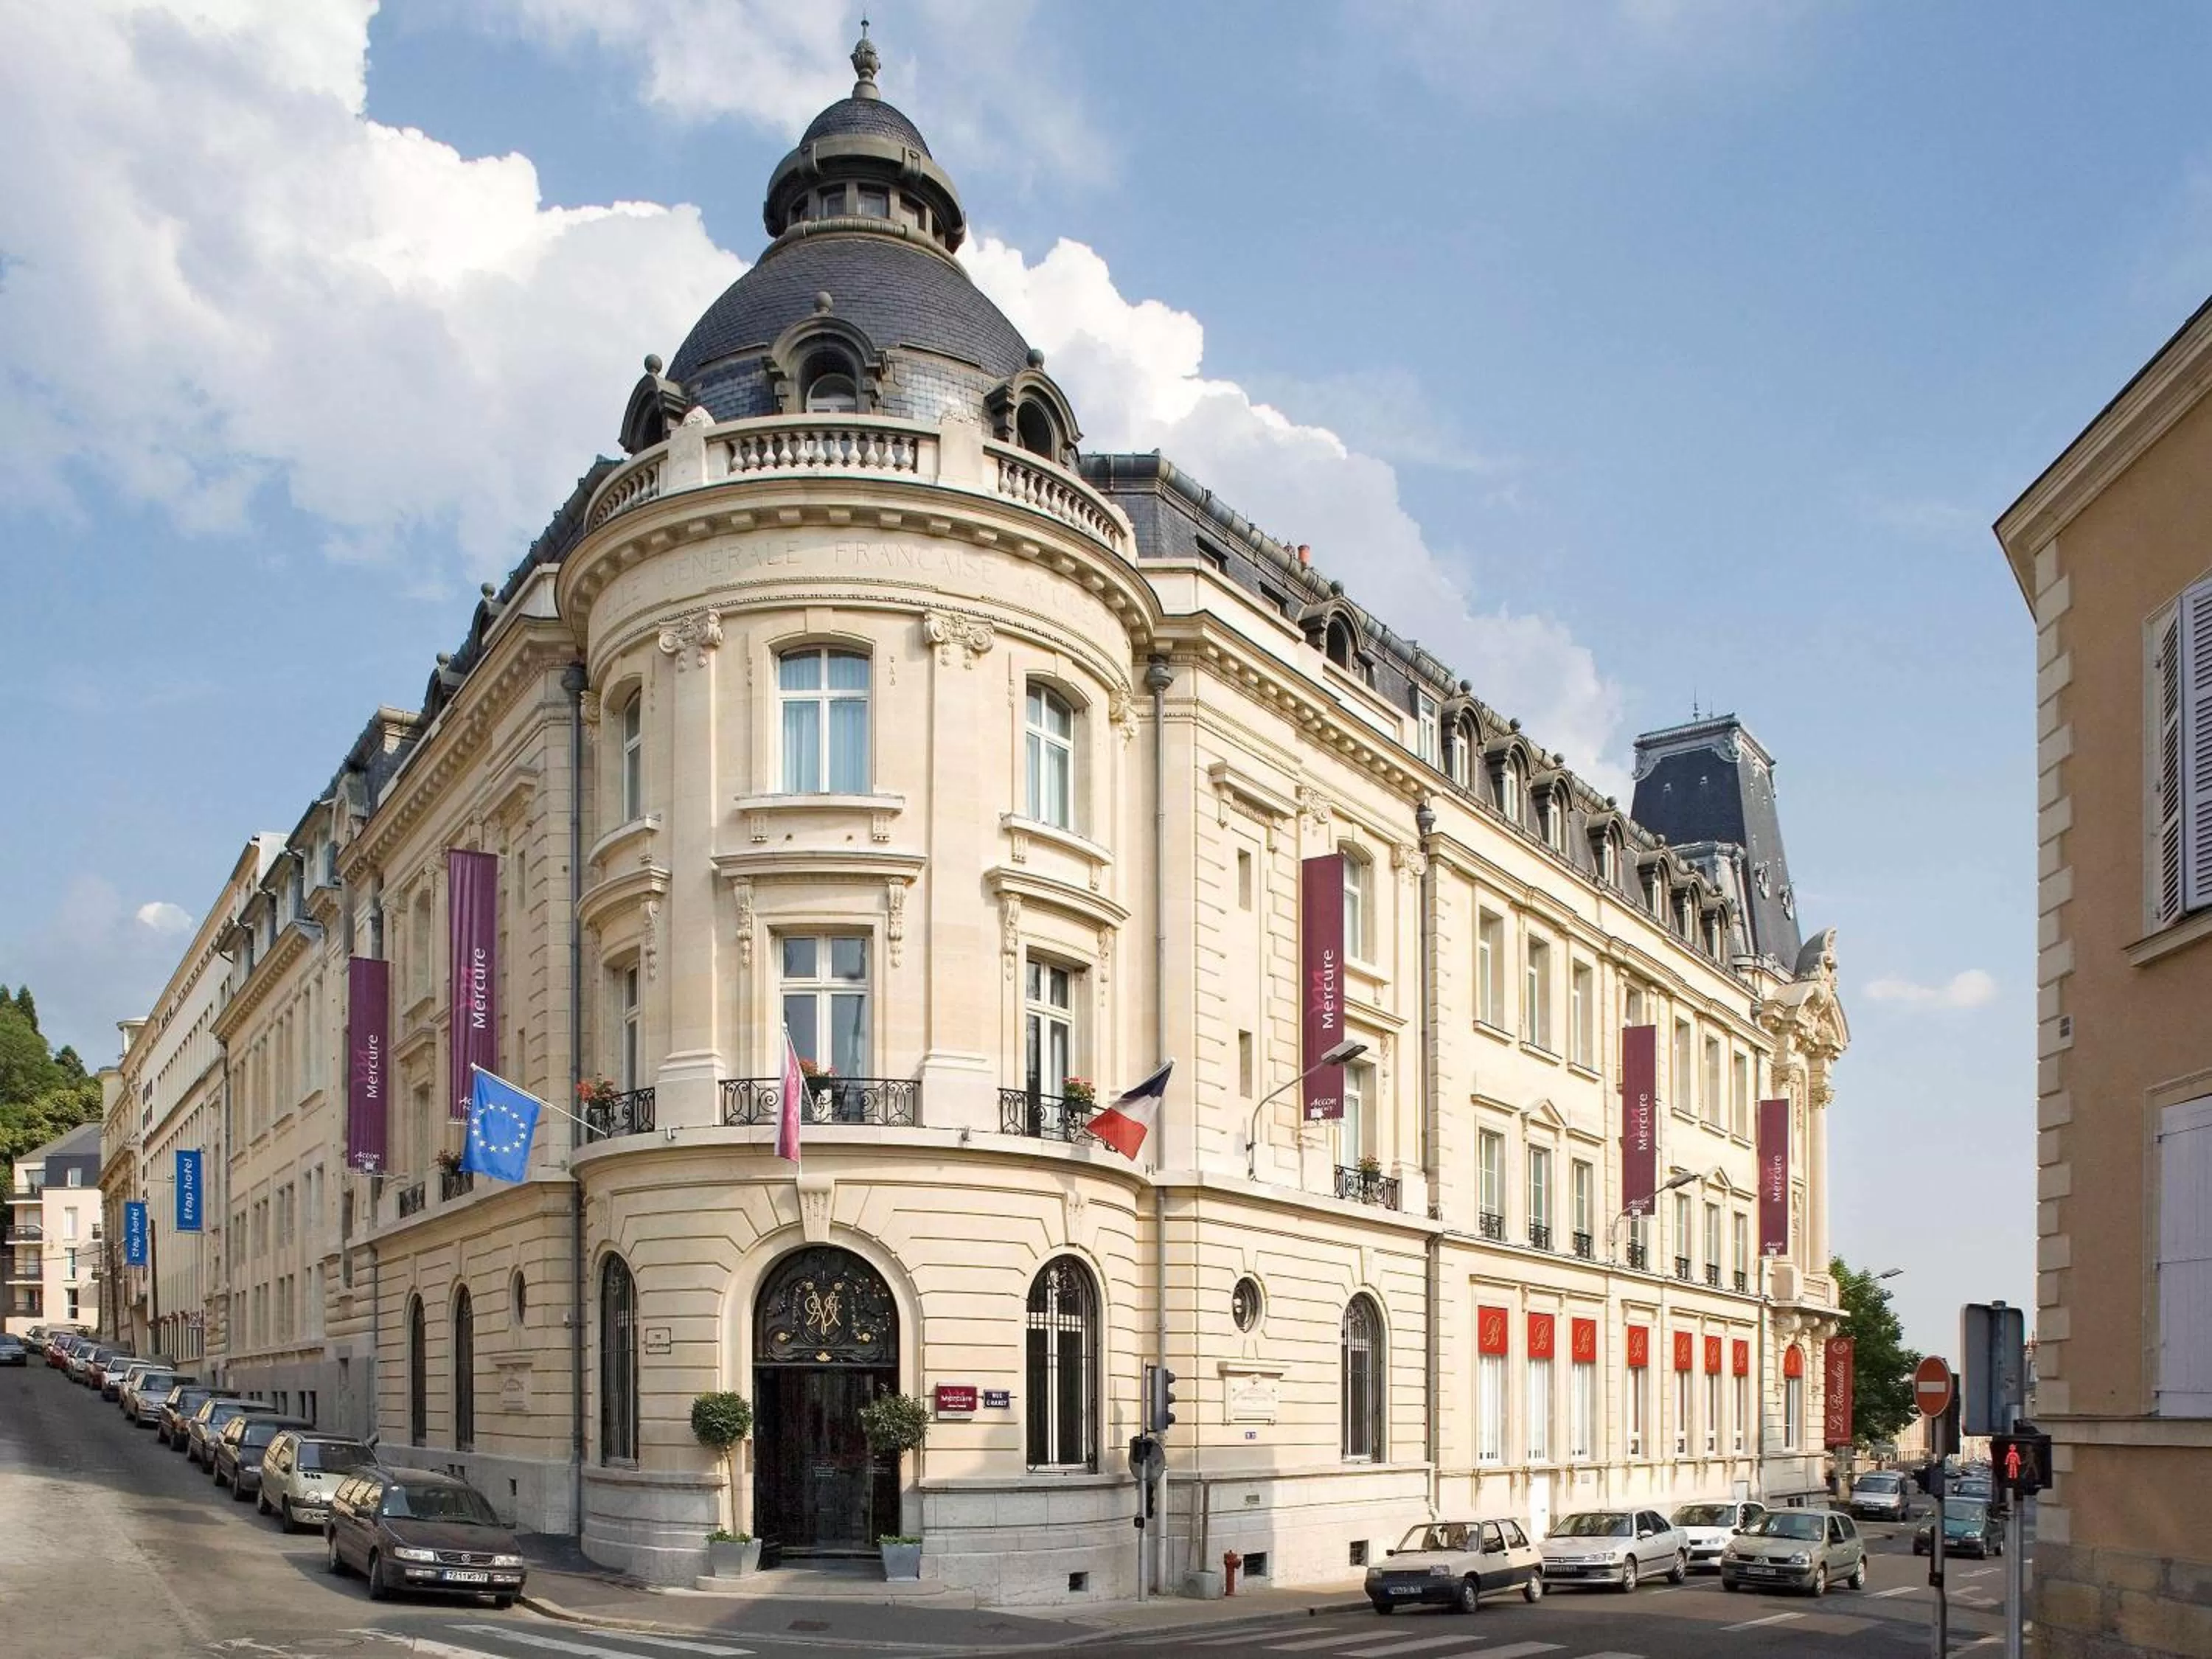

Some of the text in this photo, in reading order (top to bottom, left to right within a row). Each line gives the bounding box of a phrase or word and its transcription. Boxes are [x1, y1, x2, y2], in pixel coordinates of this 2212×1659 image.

[473, 947, 486, 1029] Mercure
[1321, 949, 1334, 1030] Mercure
[366, 1034, 378, 1099] Mercure
[1638, 1093, 1649, 1151] Mercure
[1773, 1155, 1782, 1203] Mercure
